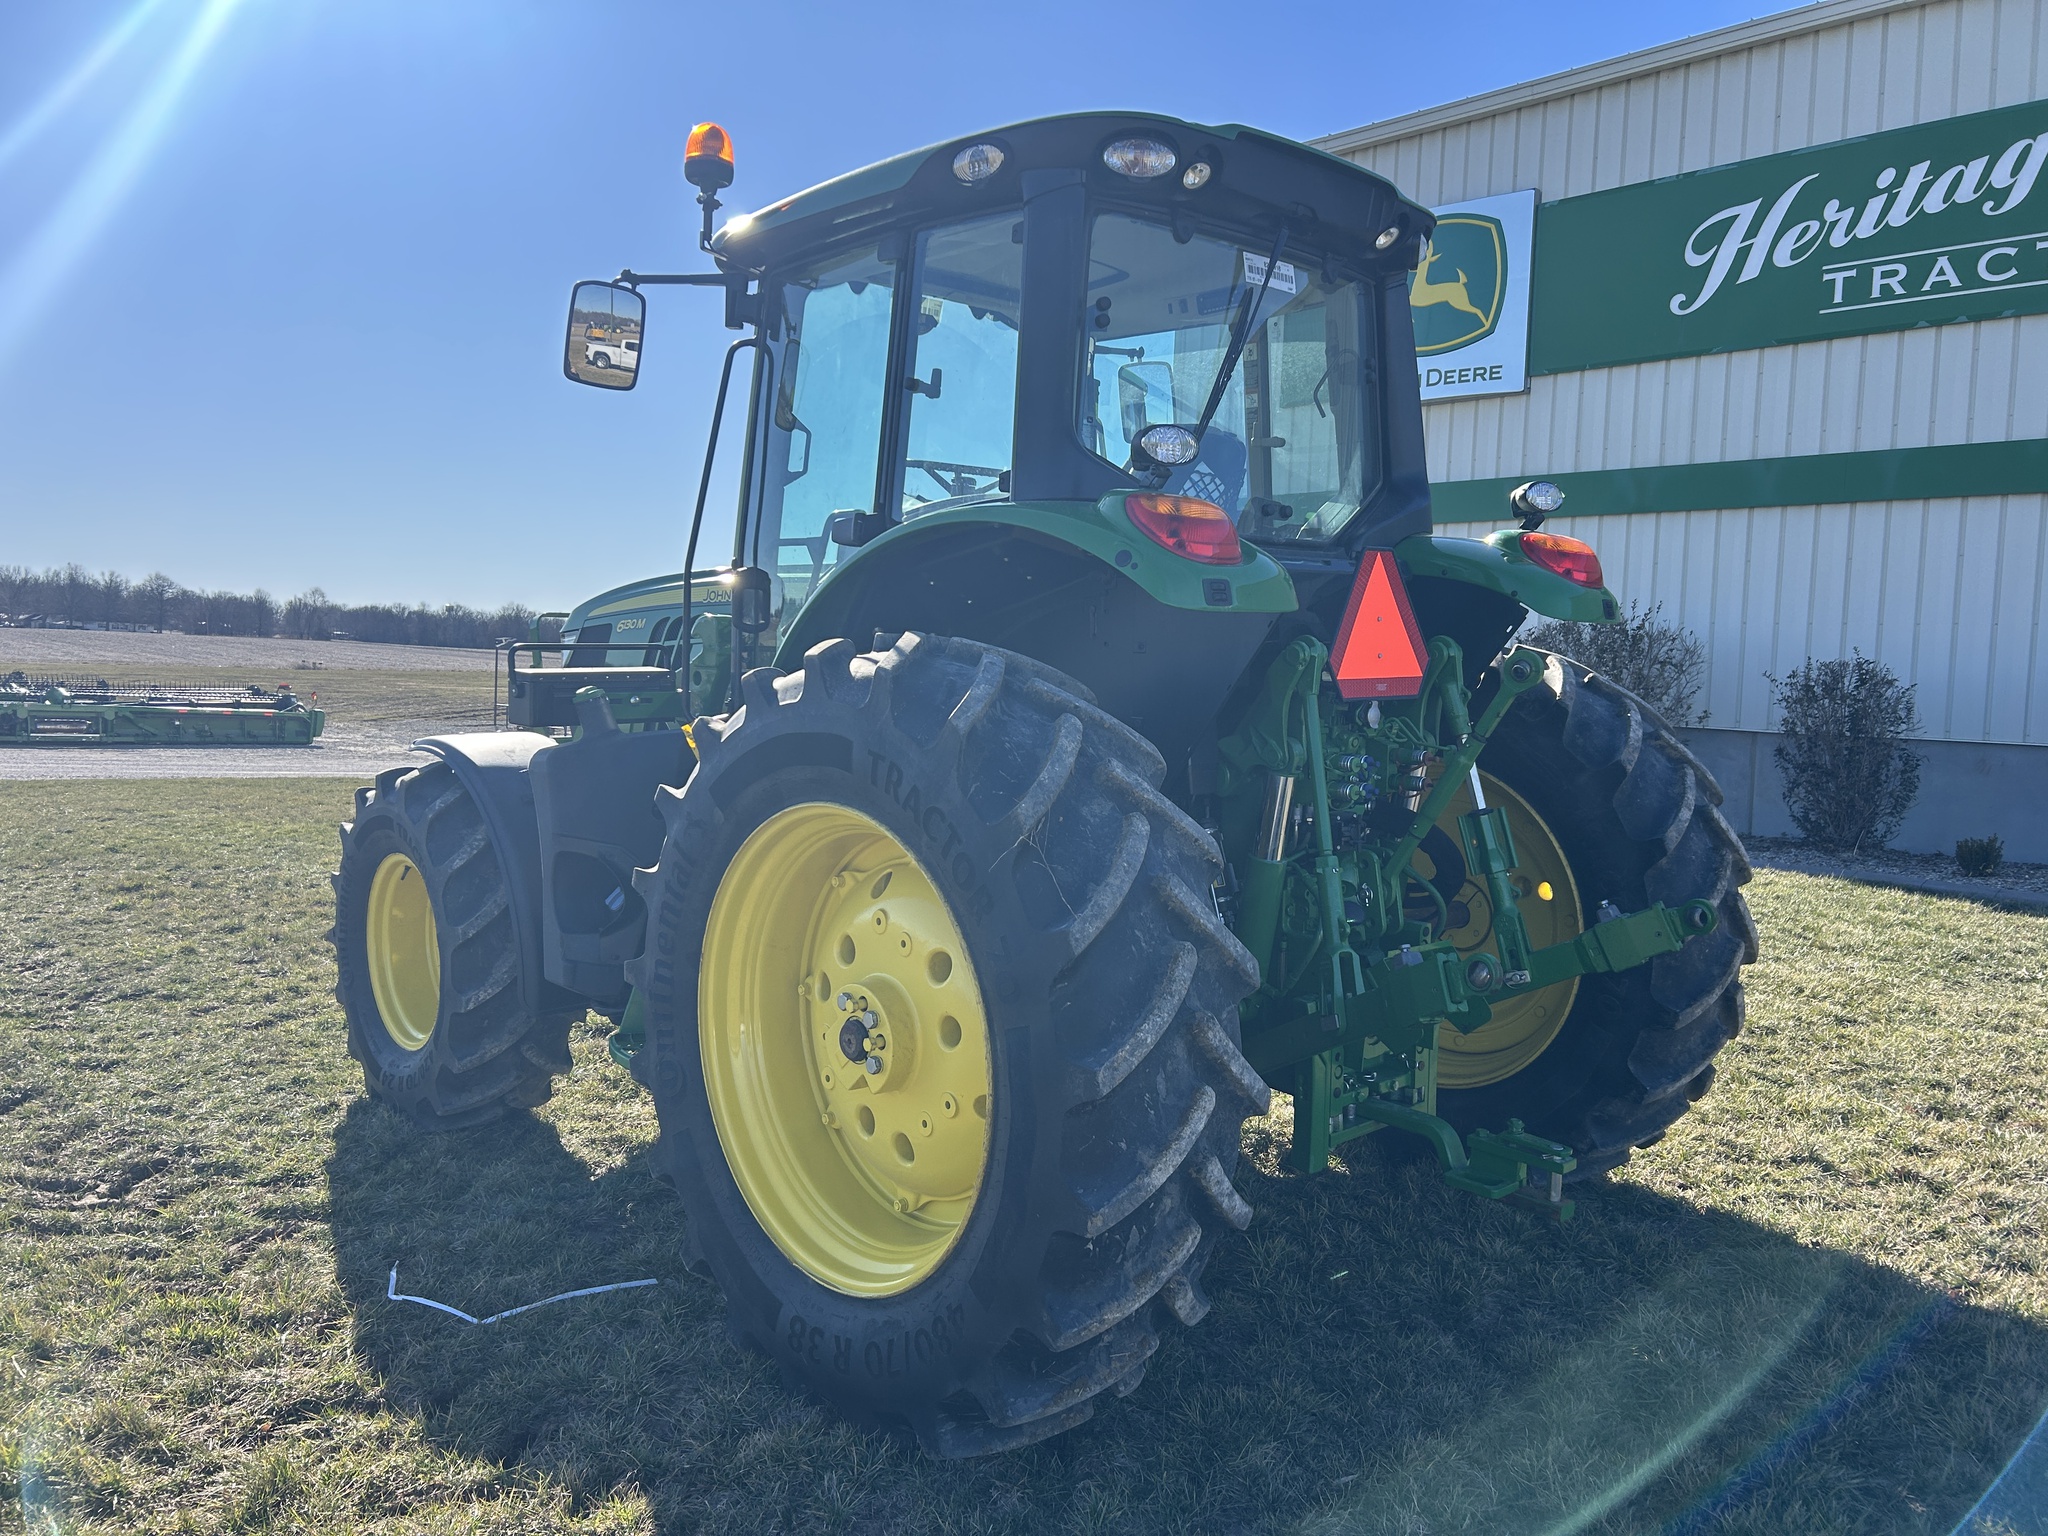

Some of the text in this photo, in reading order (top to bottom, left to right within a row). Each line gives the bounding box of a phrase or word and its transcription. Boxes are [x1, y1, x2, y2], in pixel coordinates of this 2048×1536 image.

[866, 747, 996, 928] TRACTOR
[787, 1314, 826, 1366] 38
[833, 1334, 852, 1377] R
